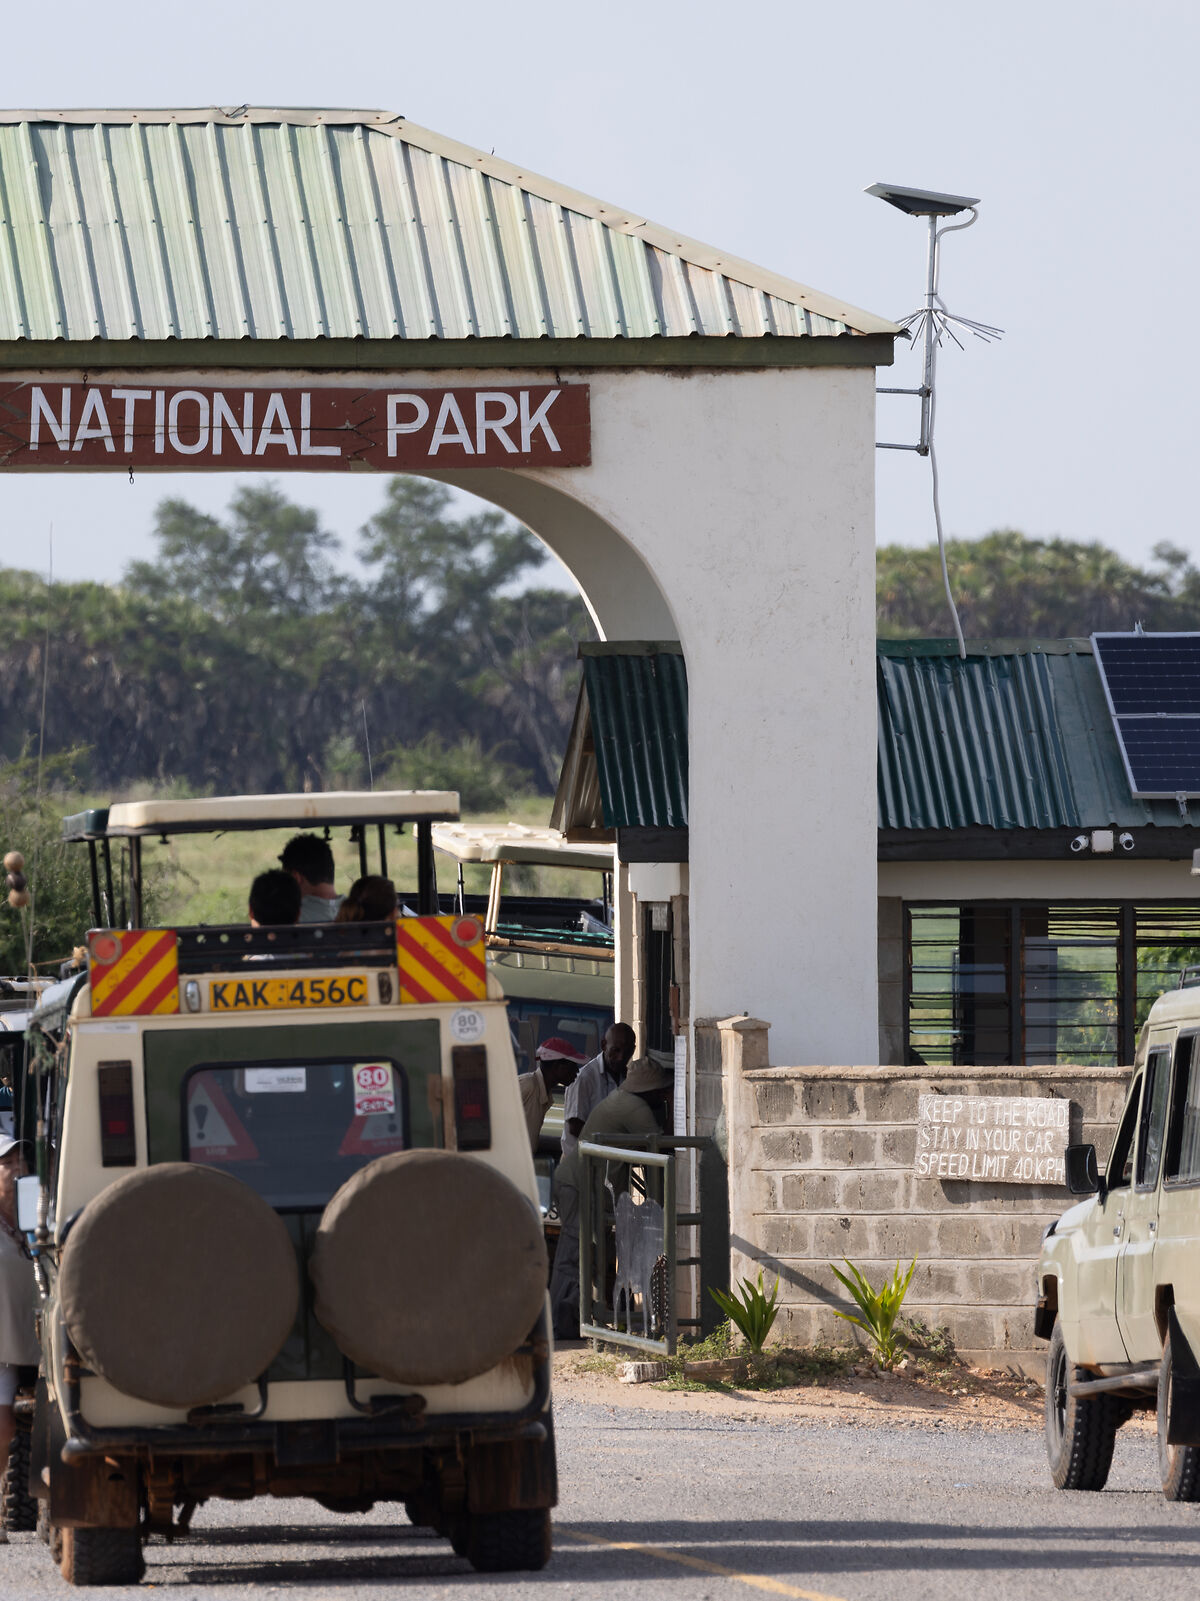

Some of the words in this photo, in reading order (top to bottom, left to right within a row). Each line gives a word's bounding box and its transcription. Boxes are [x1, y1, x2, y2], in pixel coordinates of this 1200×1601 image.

[29, 386, 341, 457] NATIONAL
[387, 389, 562, 457] PARK
[212, 981, 270, 1008] KAK
[289, 977, 365, 1005] 456C
[457, 1014, 477, 1027] 80
[359, 1068, 386, 1086] 80
[922, 1100, 963, 1123] KEEP
[968, 1101, 987, 1124] TO
[993, 1102, 1022, 1126] THE
[1025, 1103, 1067, 1128] ROAD
[920, 1126, 962, 1150] STAY
[965, 1128, 980, 1150] IN
[984, 1129, 1022, 1152] YOUR
[1025, 1131, 1053, 1154] CAR
[918, 1152, 969, 1176] SPEED
[972, 1154, 1009, 1178] LIMIT
